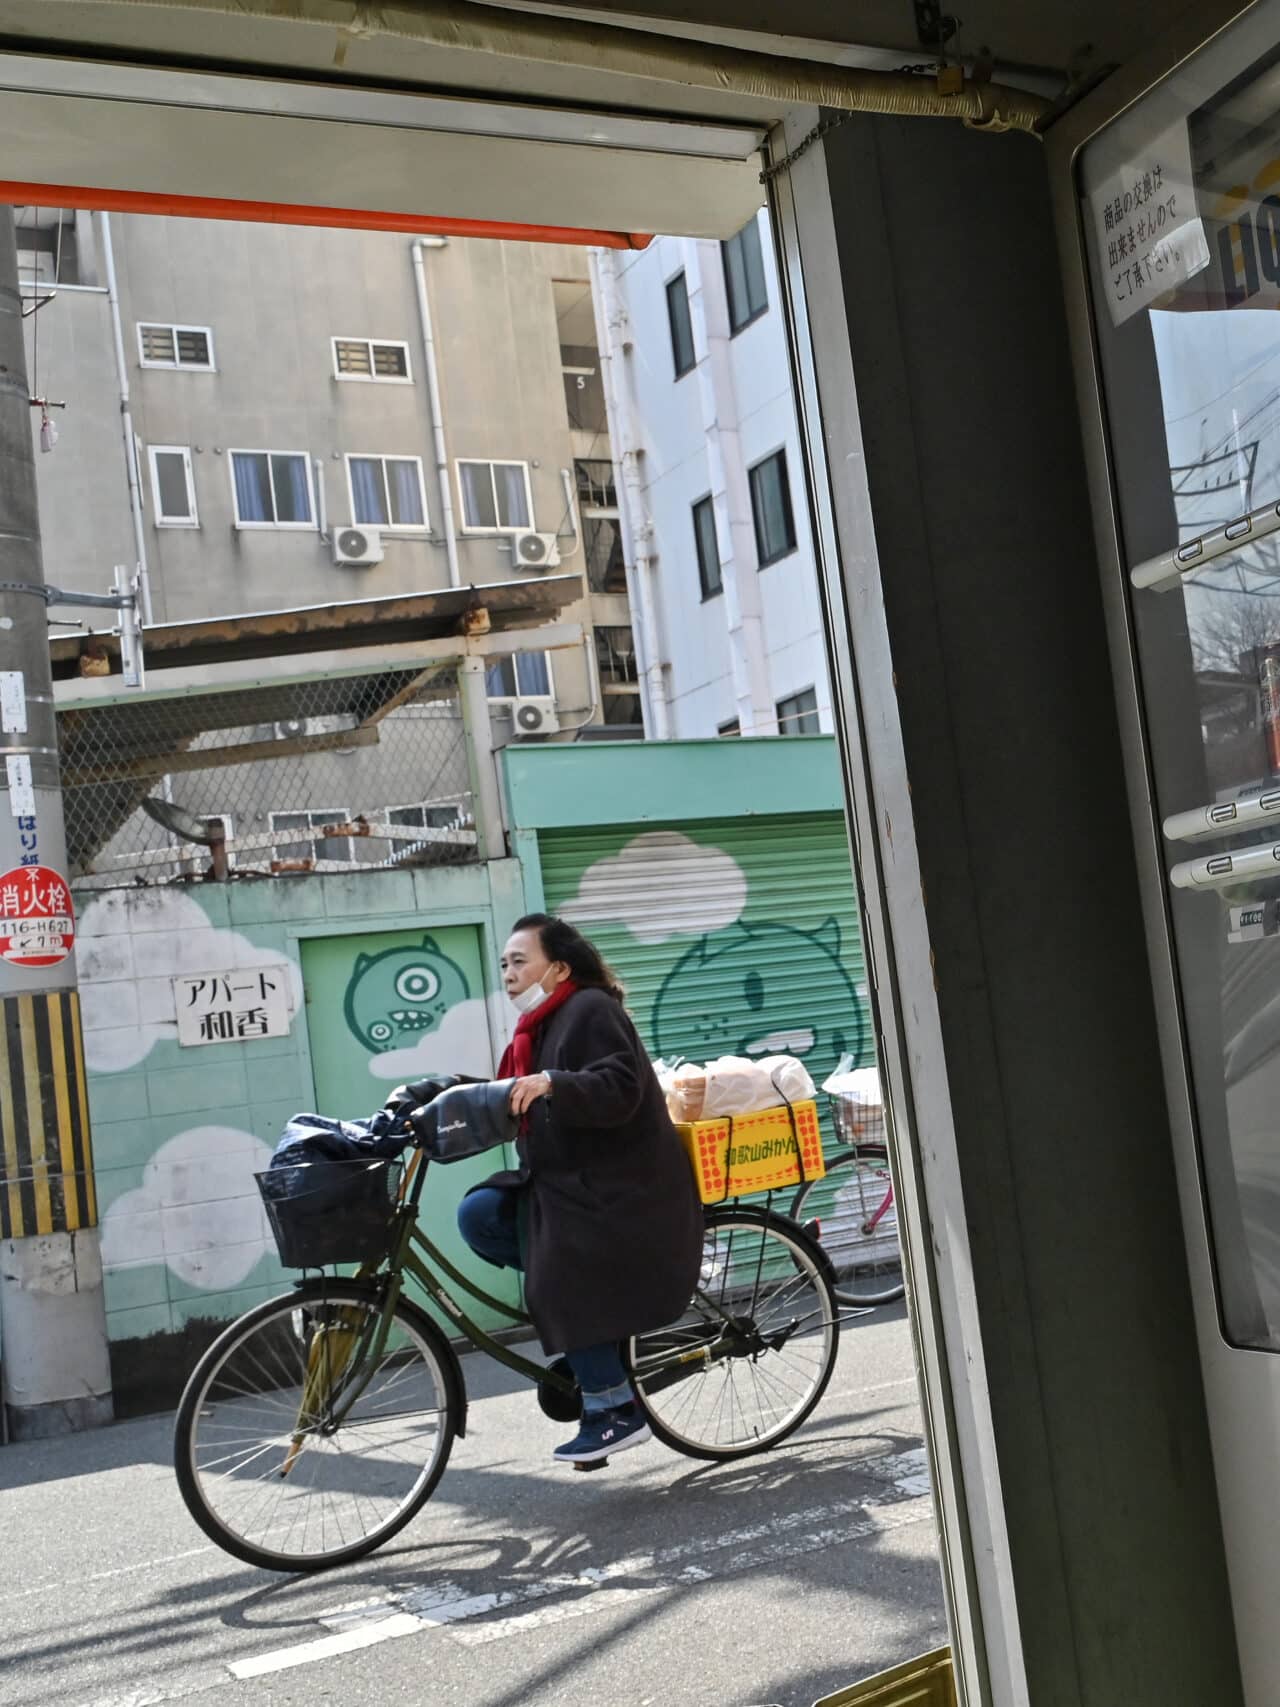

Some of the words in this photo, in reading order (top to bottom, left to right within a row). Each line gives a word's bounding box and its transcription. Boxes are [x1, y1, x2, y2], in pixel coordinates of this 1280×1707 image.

[1104, 164, 1163, 231] 商品の交換は
[1108, 195, 1177, 268] 出来ませんので
[577, 376, 586, 390] 5
[0, 882, 67, 917] 消火栓
[183, 972, 277, 1007] アパート
[200, 1007, 269, 1041] 和香
